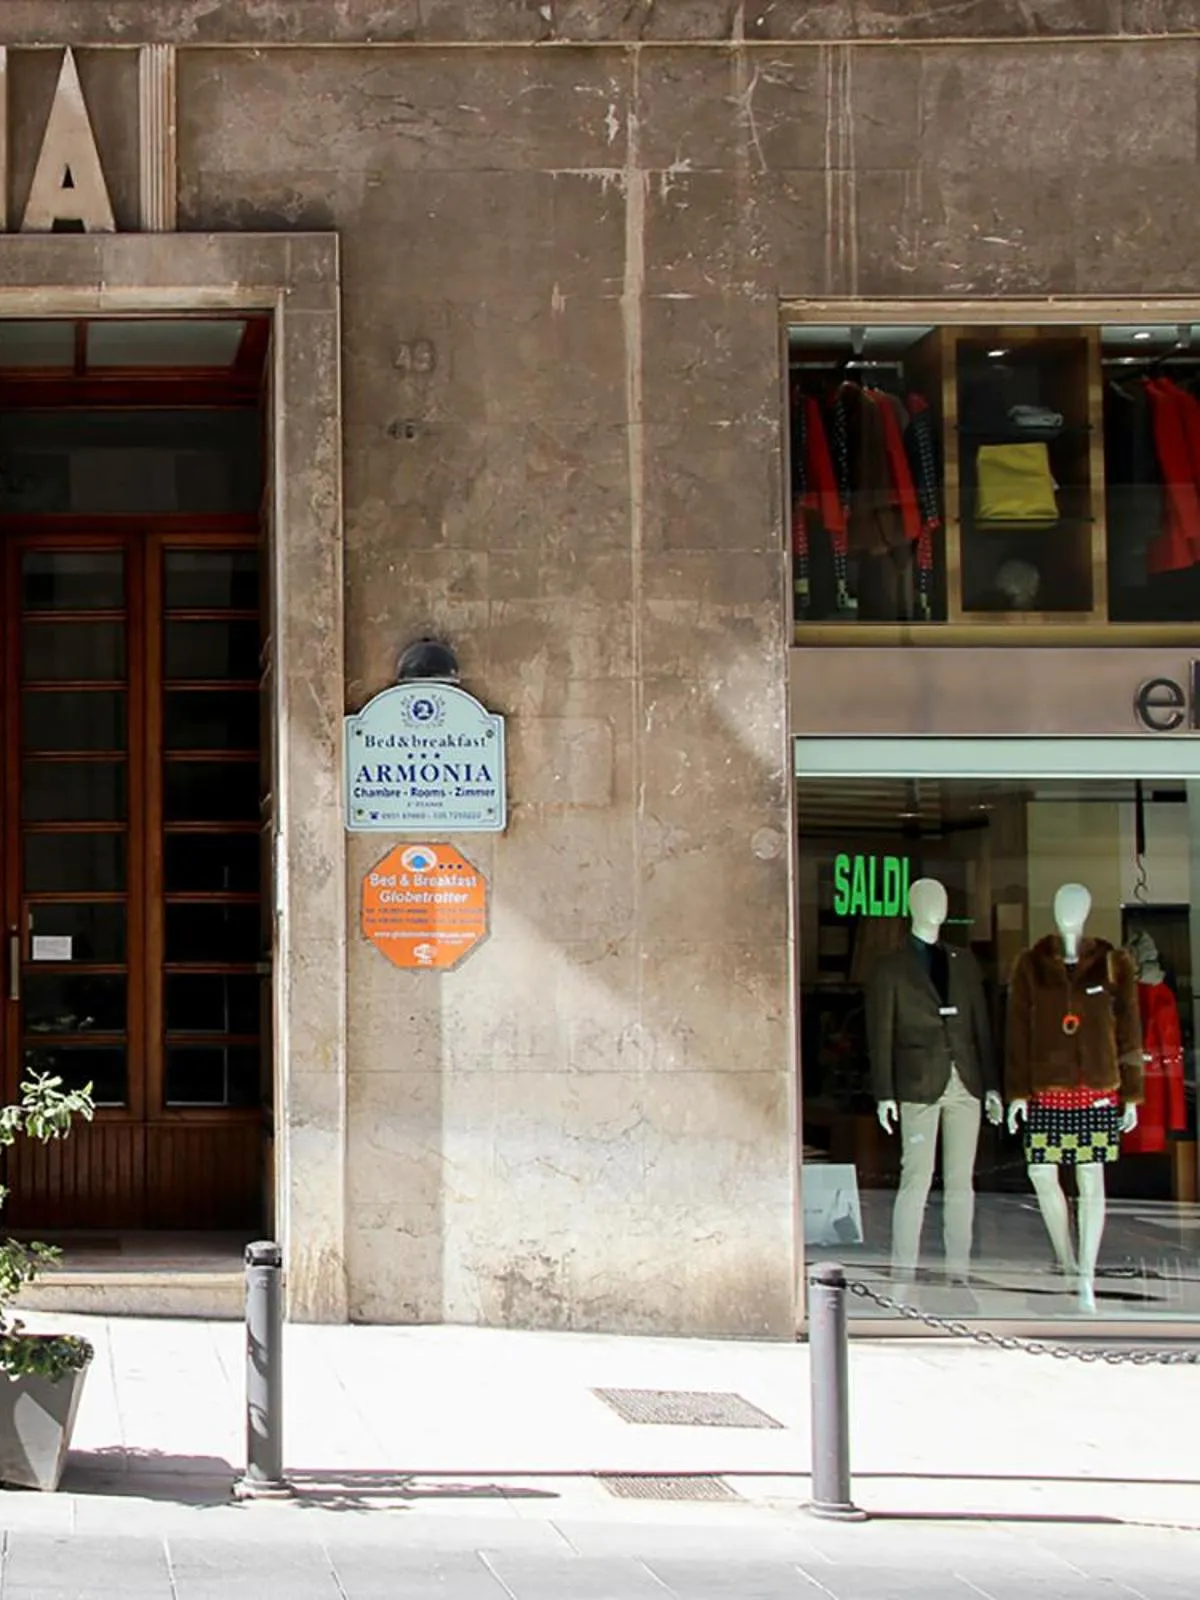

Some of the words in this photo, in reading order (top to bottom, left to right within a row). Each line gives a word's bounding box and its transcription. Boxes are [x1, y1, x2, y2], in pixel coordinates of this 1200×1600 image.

[356, 764, 492, 783] ARMONIA
[353, 786, 401, 798] Chambre
[410, 786, 445, 798] Rooms
[455, 786, 495, 798] Zimmer
[369, 873, 397, 887] Bed
[400, 873, 409, 887] &
[413, 873, 477, 887] Breakfast
[834, 854, 911, 917] SALDI
[379, 890, 469, 904] Globetrotter
